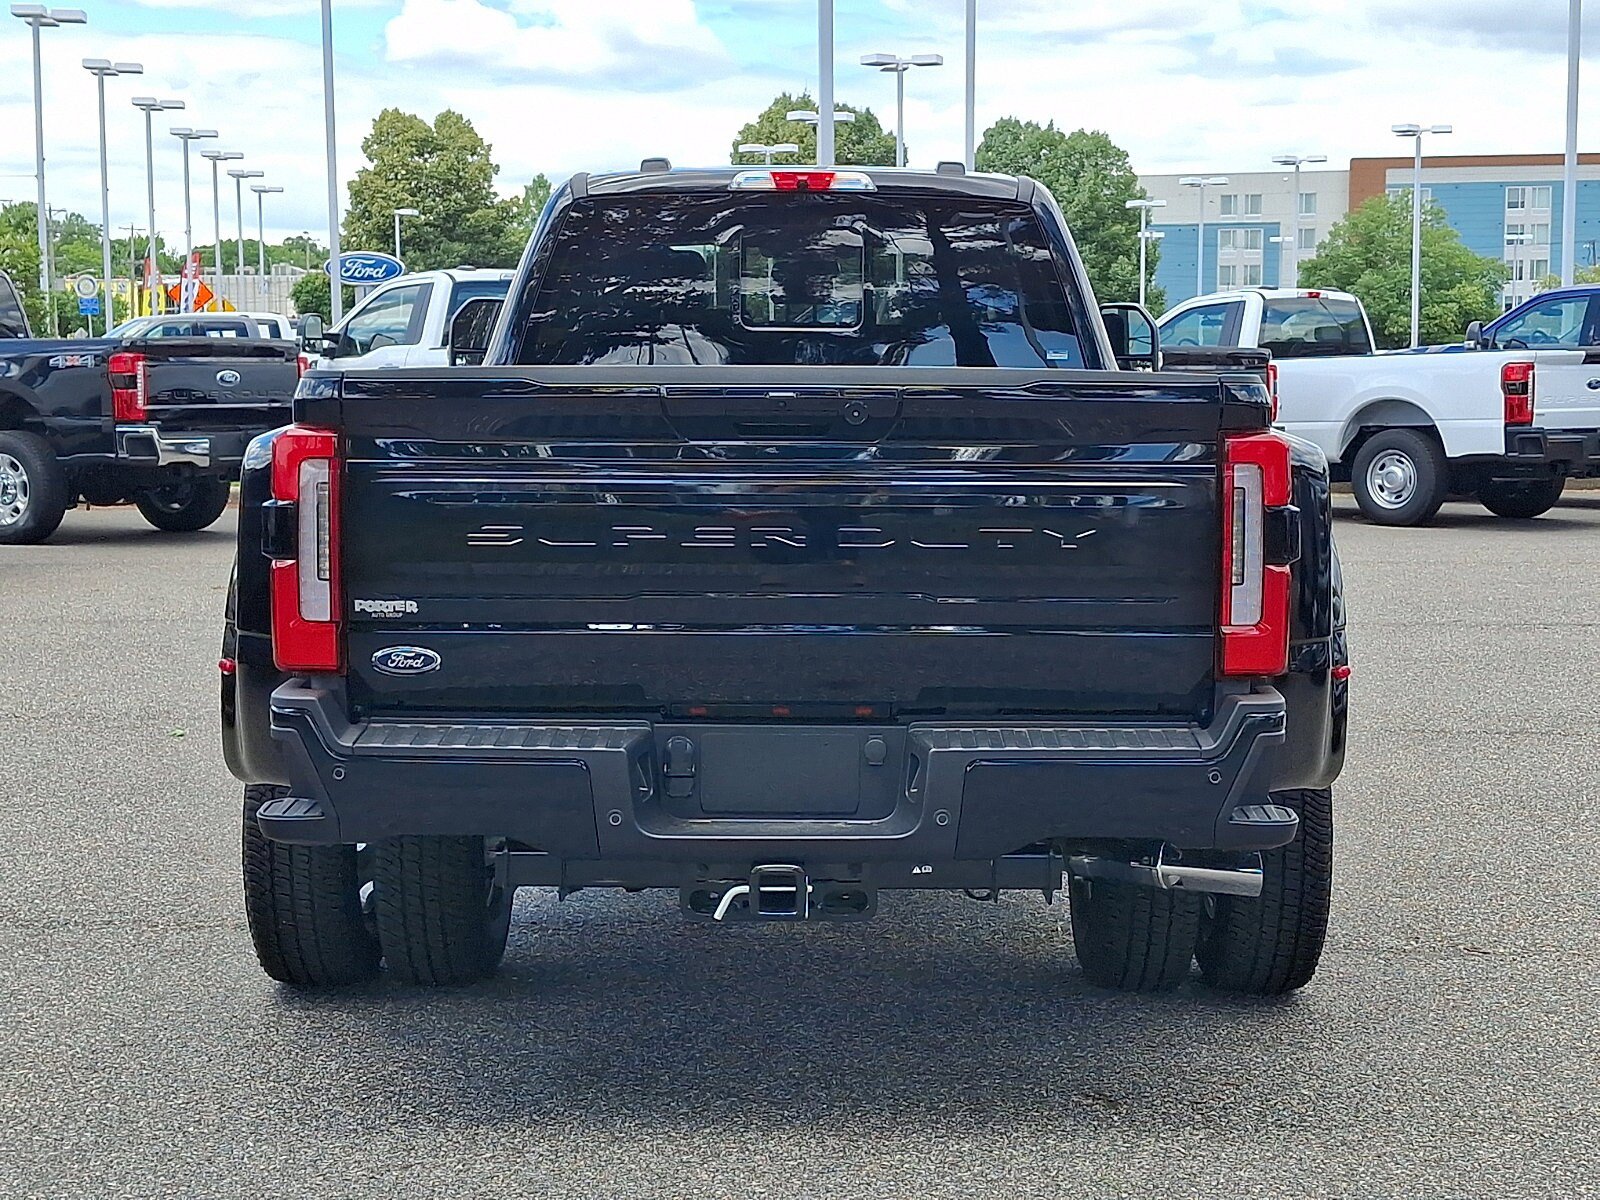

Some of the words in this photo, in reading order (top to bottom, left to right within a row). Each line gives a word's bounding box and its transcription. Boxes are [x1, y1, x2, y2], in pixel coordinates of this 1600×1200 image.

[341, 258, 387, 278] Ford
[157, 389, 234, 400] SUPER
[466, 525, 808, 547] SUPER
[837, 527, 1097, 549] DUTY
[354, 600, 419, 613] PORTER
[387, 652, 424, 668] Ford
